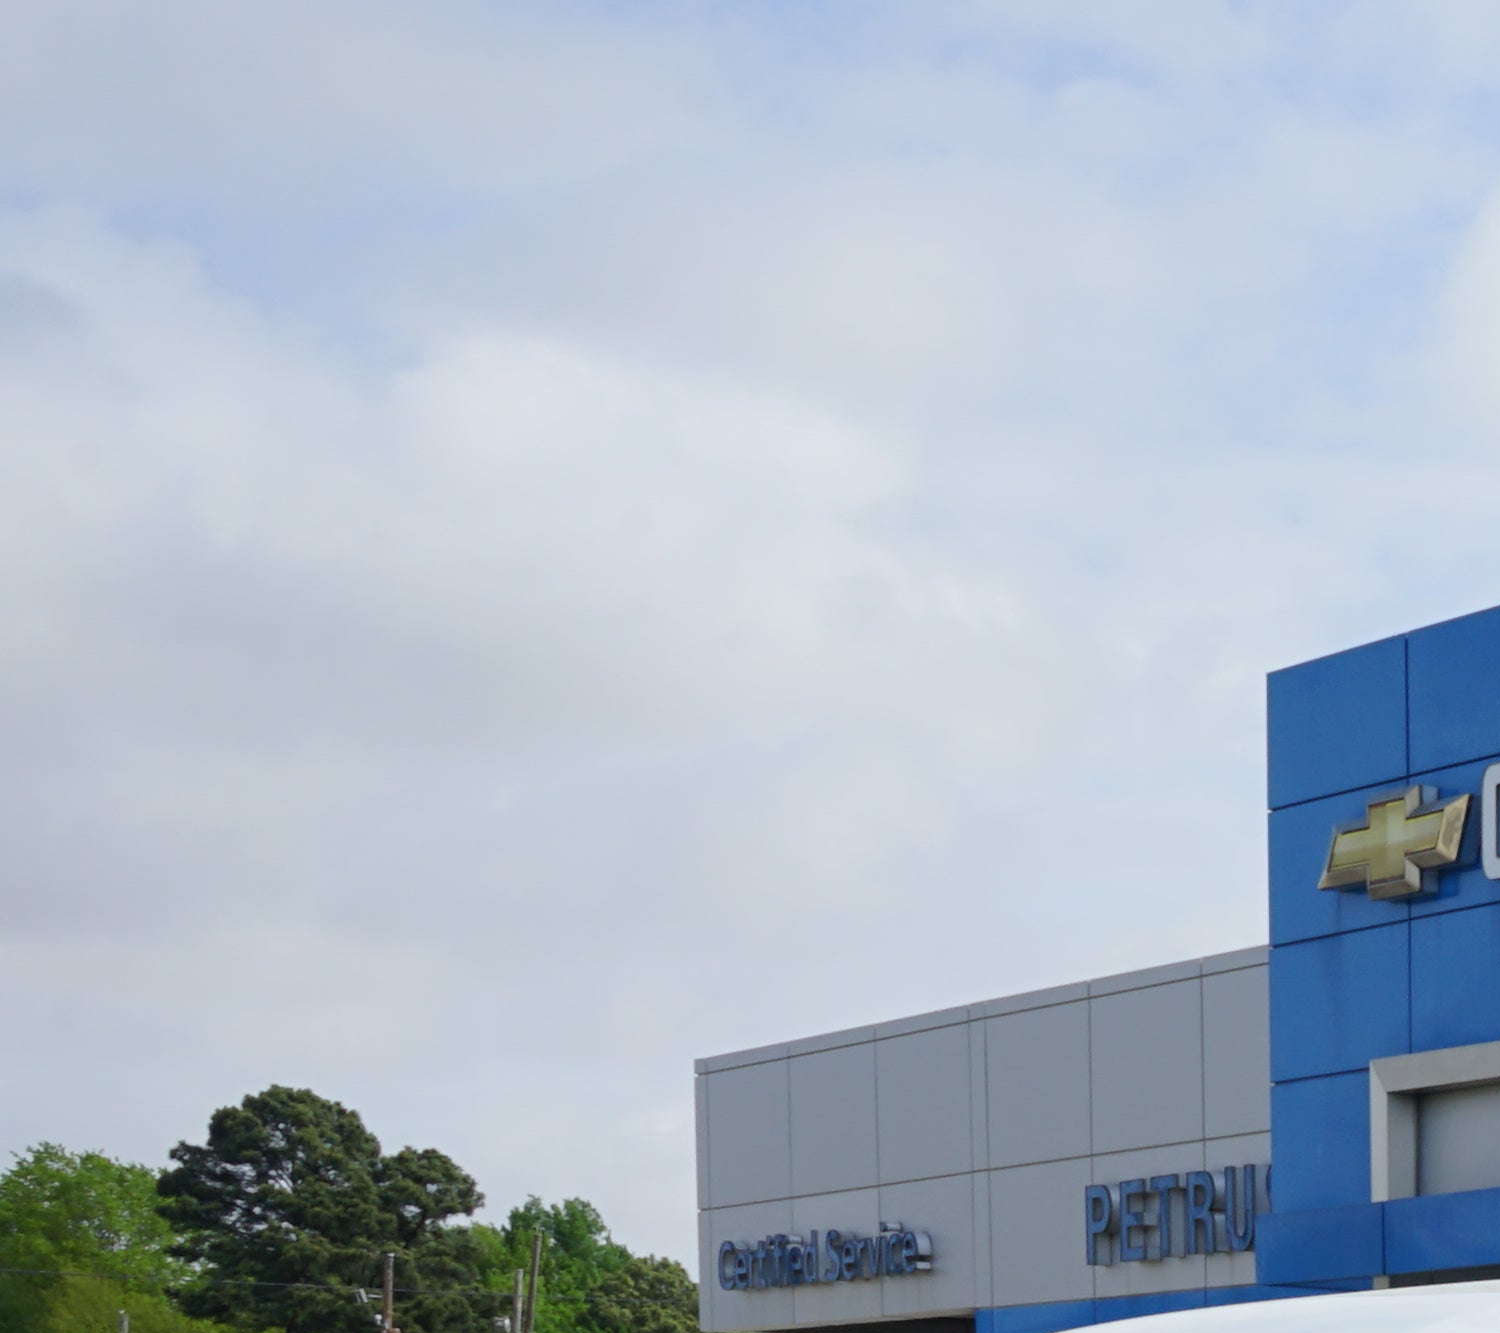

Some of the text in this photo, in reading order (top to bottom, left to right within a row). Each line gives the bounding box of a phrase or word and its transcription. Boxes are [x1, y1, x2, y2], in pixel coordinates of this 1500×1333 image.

[718, 1222, 922, 1290] Certified Service
[1085, 1164, 1271, 1267] PETRU
